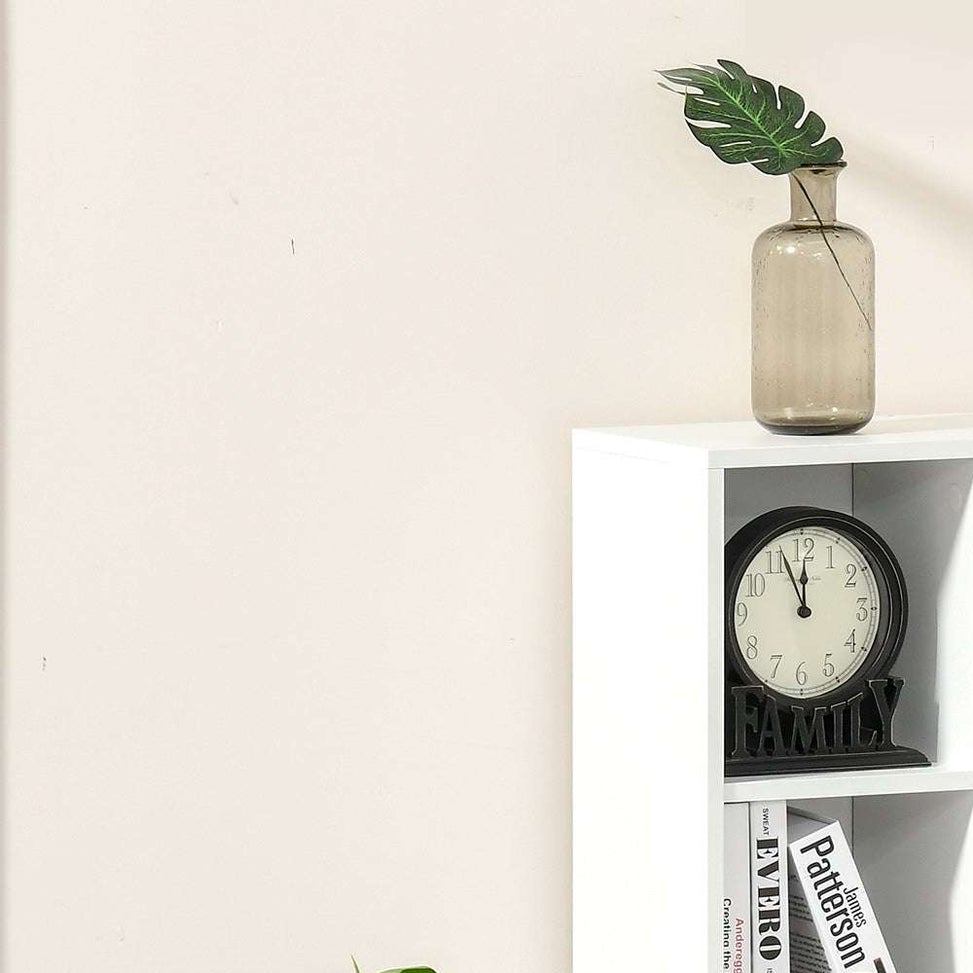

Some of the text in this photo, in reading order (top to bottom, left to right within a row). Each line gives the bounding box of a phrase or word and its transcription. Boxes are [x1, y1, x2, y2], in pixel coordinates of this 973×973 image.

[765, 548, 784, 575] 11
[791, 537, 815, 563] 12
[825, 545, 835, 569] 1
[745, 573, 766, 598] 10
[844, 563, 857, 588] 2
[736, 602, 748, 627] 9
[855, 597, 868, 621] 3
[746, 635, 758, 660] 8
[844, 628, 856, 653] 4
[770, 654, 783, 678] 7
[795, 661, 807, 686] 6
[823, 653, 835, 677] 5
[731, 677, 905, 757] FAMILY
[762, 808, 770, 836] SWEAT
[800, 835, 866, 969] Patterson
[843, 886, 867, 928] James
[723, 950, 732, 969] the
